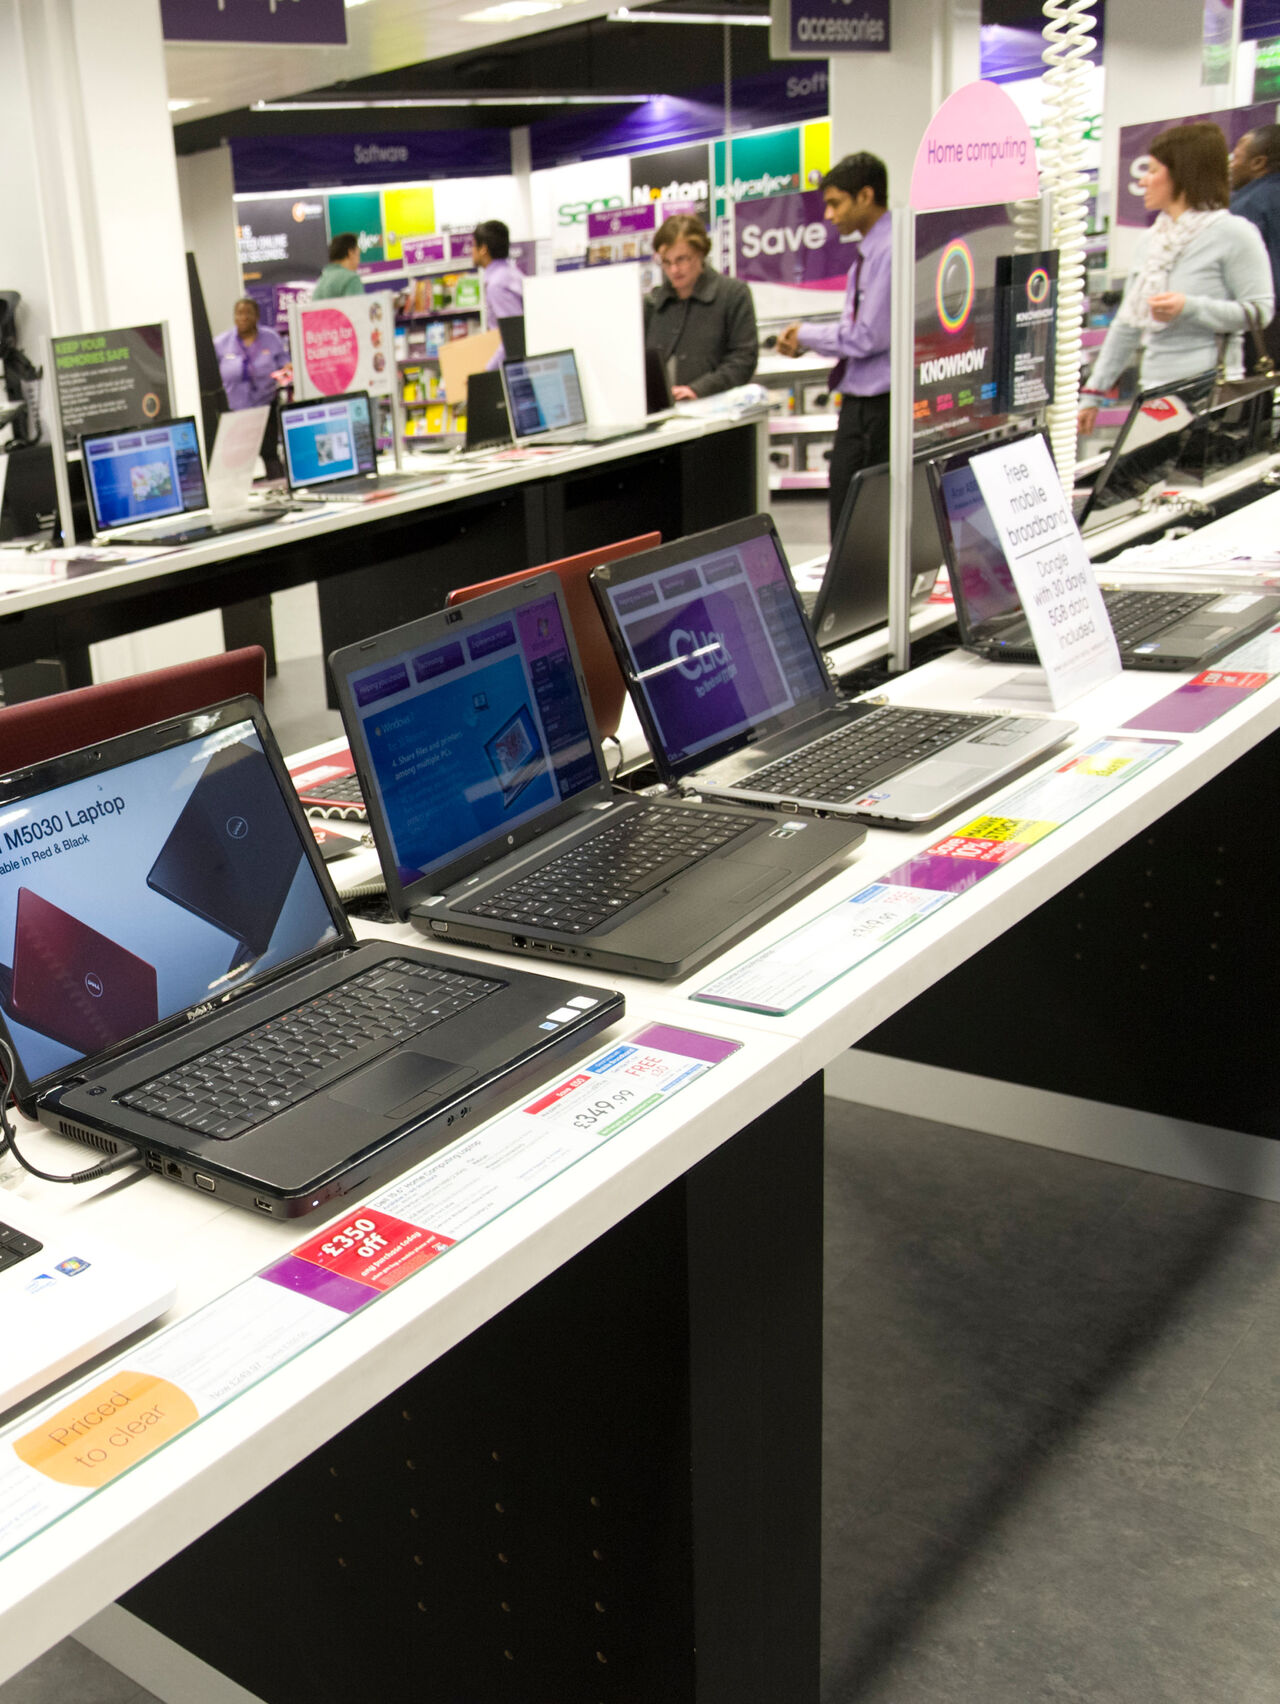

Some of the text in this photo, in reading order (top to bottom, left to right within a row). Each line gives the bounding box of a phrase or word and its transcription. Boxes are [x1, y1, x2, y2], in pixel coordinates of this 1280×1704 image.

[798, 16, 885, 41] accessories
[354, 144, 409, 165] Software
[928, 137, 1027, 166] Home computing
[741, 222, 827, 258] Save
[920, 348, 989, 385] KNOWHOW
[1003, 461, 1030, 485] Free
[1009, 486, 1047, 515] mobile
[1006, 507, 1070, 547] broadband
[1036, 552, 1070, 580] Dongle
[1032, 585, 1053, 608] with
[1053, 580, 1066, 599] 30
[1048, 595, 1090, 628] 5GB data
[1058, 619, 1095, 650] included
[669, 628, 733, 680] CLICK
[4, 813, 63, 851] M5030
[66, 792, 127, 835] Laptop
[21, 856, 31, 868] in
[32, 846, 52, 862] Red
[54, 842, 62, 854] &
[63, 833, 91, 852] Black
[926, 838, 965, 855] Save
[951, 841, 994, 857] 10%
[186, 1003, 217, 1023] DELL
[625, 1056, 663, 1077] FREE
[555, 1088, 571, 1097] Save
[573, 1089, 634, 1129] £349.99
[321, 1219, 376, 1257] £350
[357, 1232, 389, 1258] off
[361, 1231, 422, 1277] any purchase today
[48, 1390, 133, 1448] Priced
[74, 1403, 167, 1469] to clear
